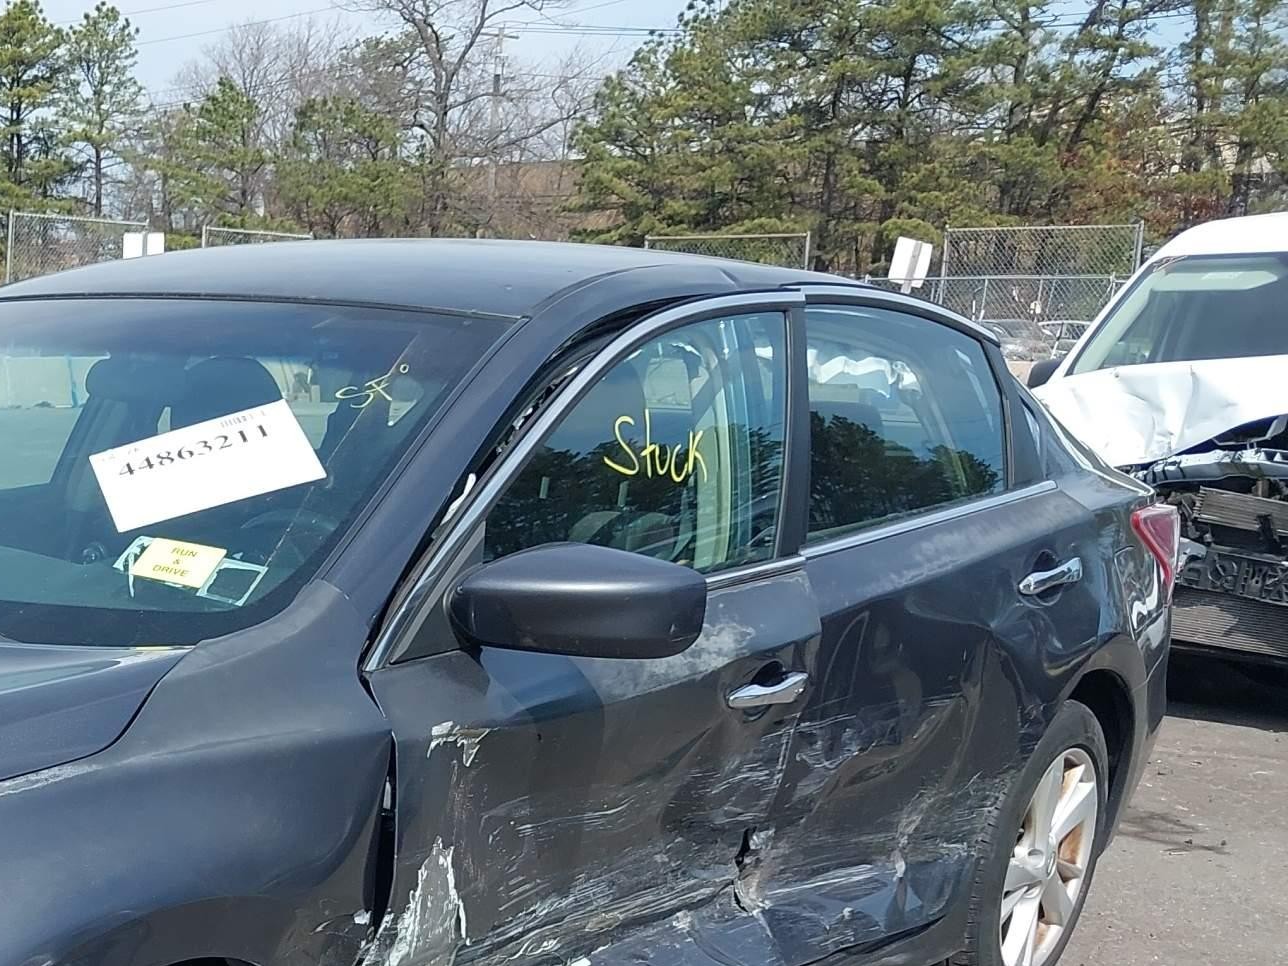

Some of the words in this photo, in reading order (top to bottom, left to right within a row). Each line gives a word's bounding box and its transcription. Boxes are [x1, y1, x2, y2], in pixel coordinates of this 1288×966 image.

[118, 423, 268, 477] 44863211
[171, 546, 198, 558] RUN
[152, 563, 191, 578] DRIVE
